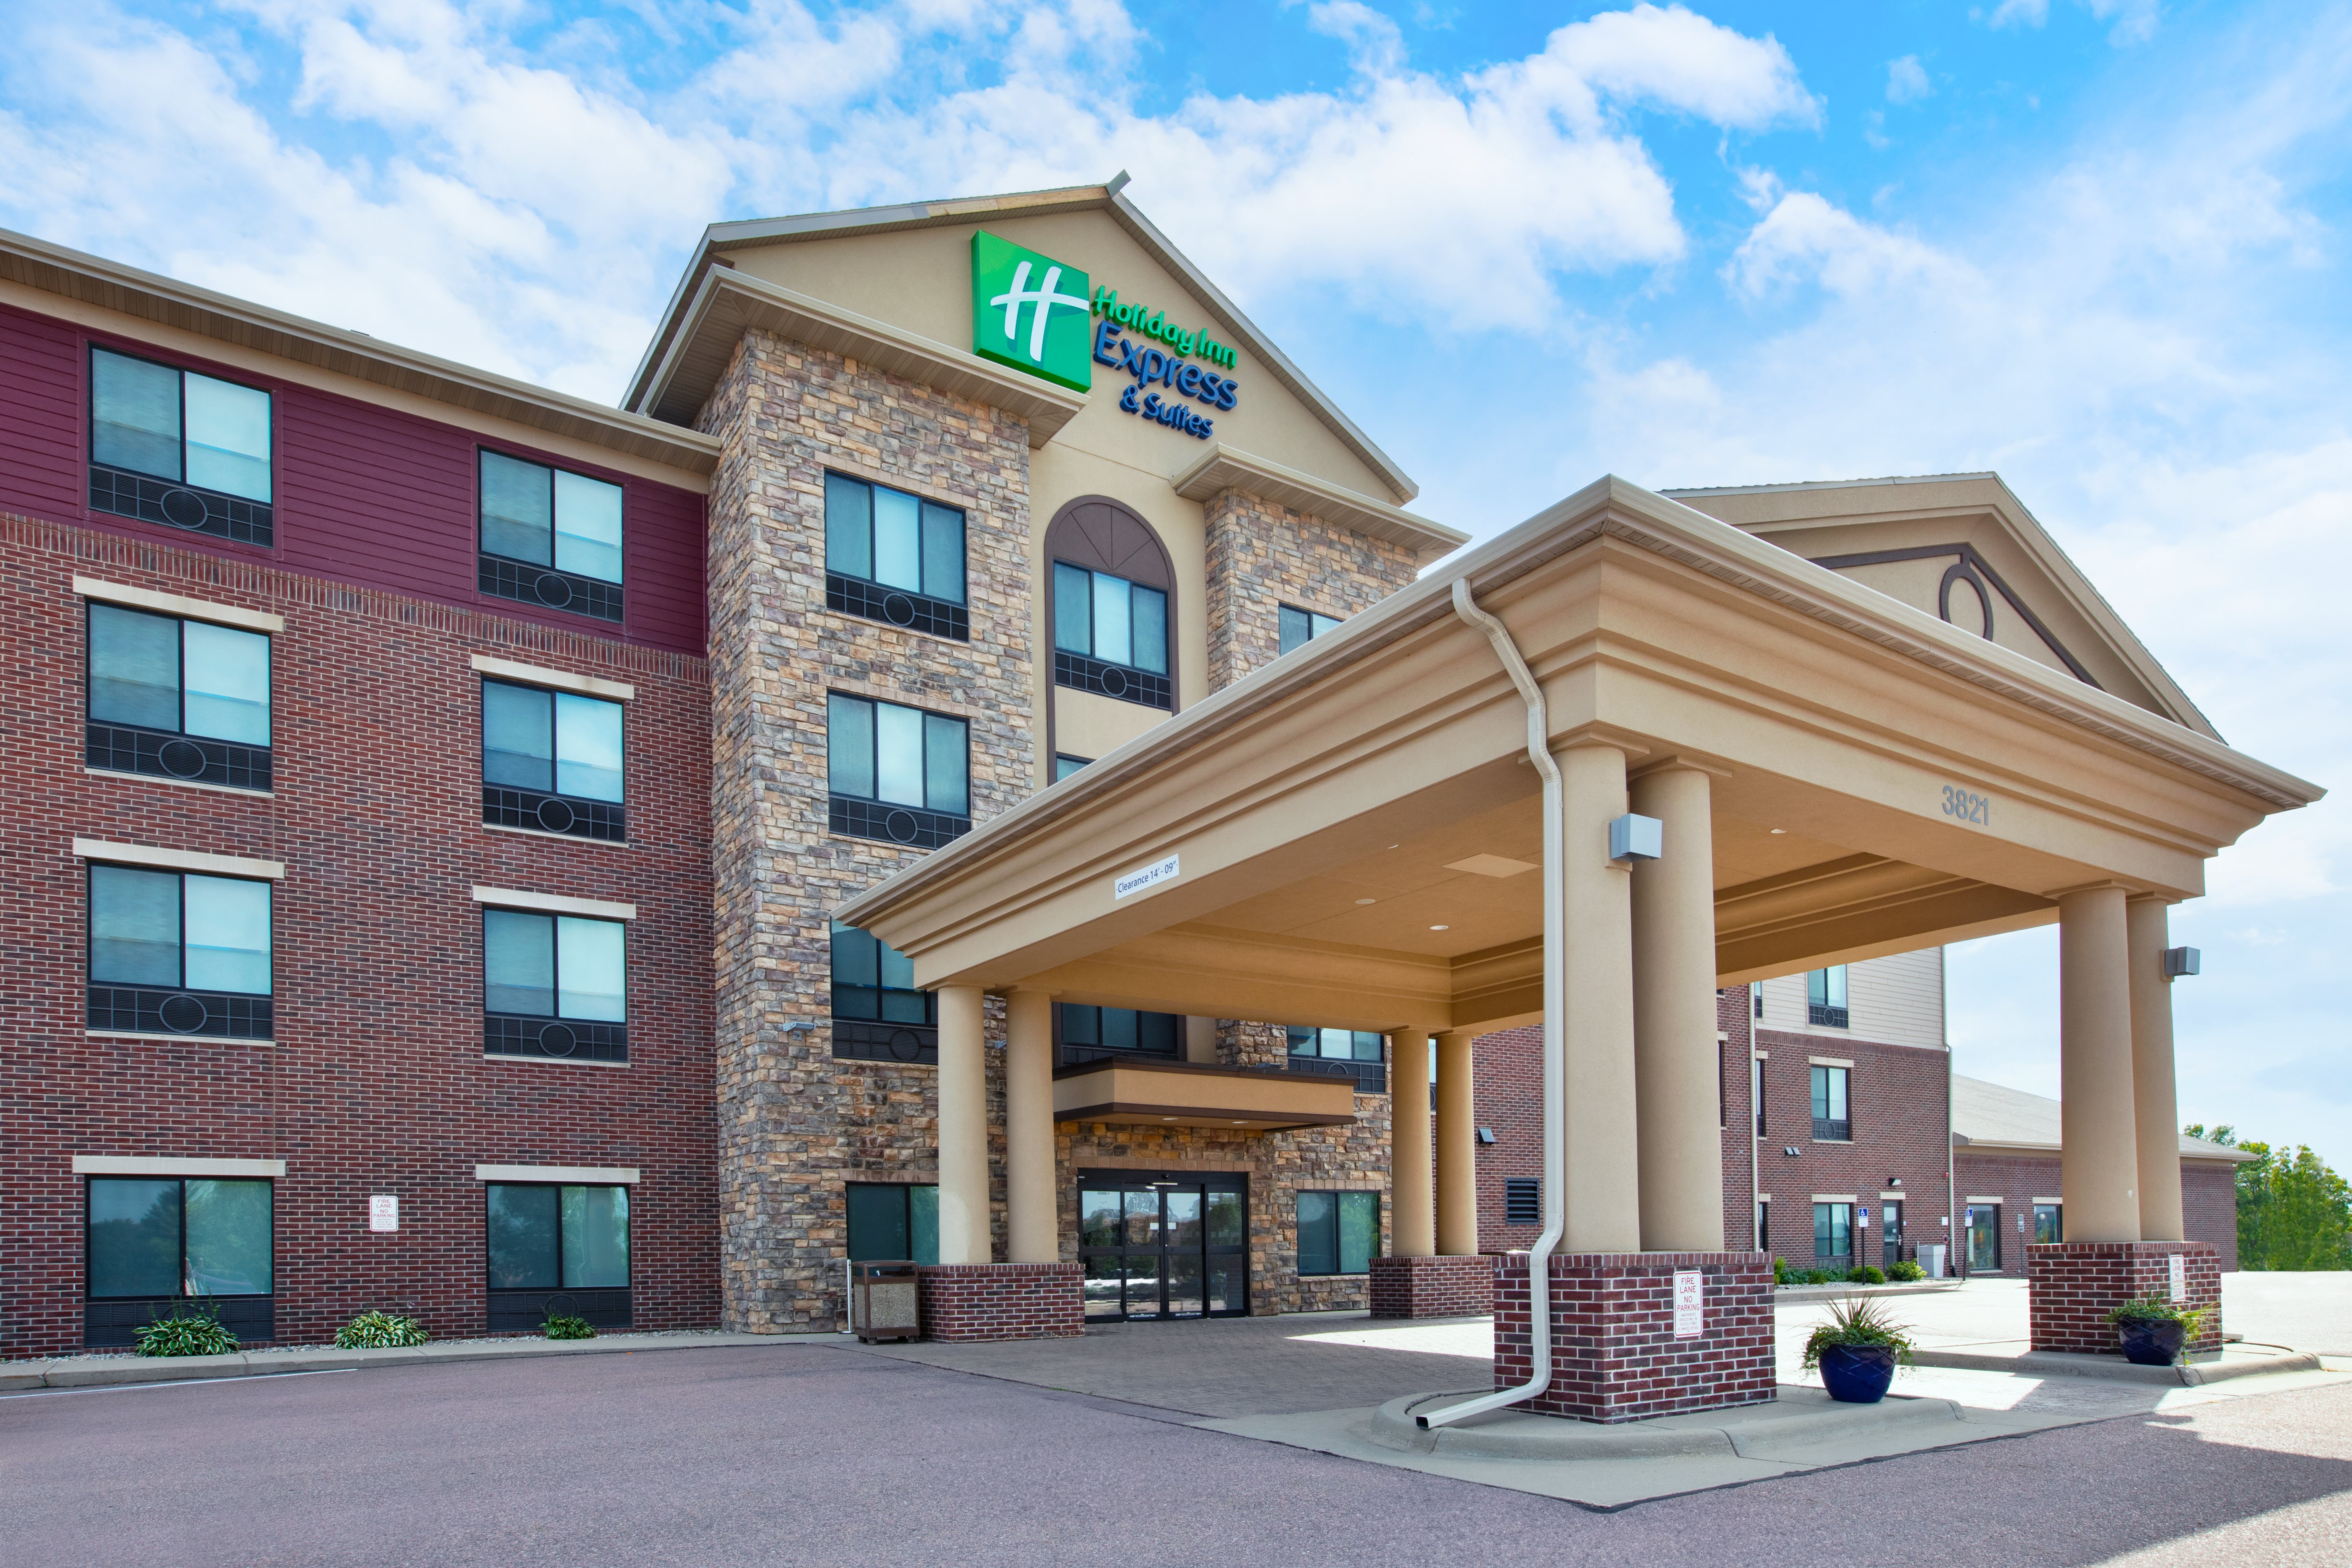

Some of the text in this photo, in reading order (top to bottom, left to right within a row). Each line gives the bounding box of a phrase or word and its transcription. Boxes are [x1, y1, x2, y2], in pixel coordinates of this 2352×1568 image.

[1091, 285, 1237, 370] Holiday Inn
[1093, 320, 1238, 411] Express
[1119, 385, 1213, 439] & Suites
[1942, 785, 1989, 826] 3821
[1118, 875, 1149, 893] Clearance
[1677, 1303, 1699, 1312] PARKING
